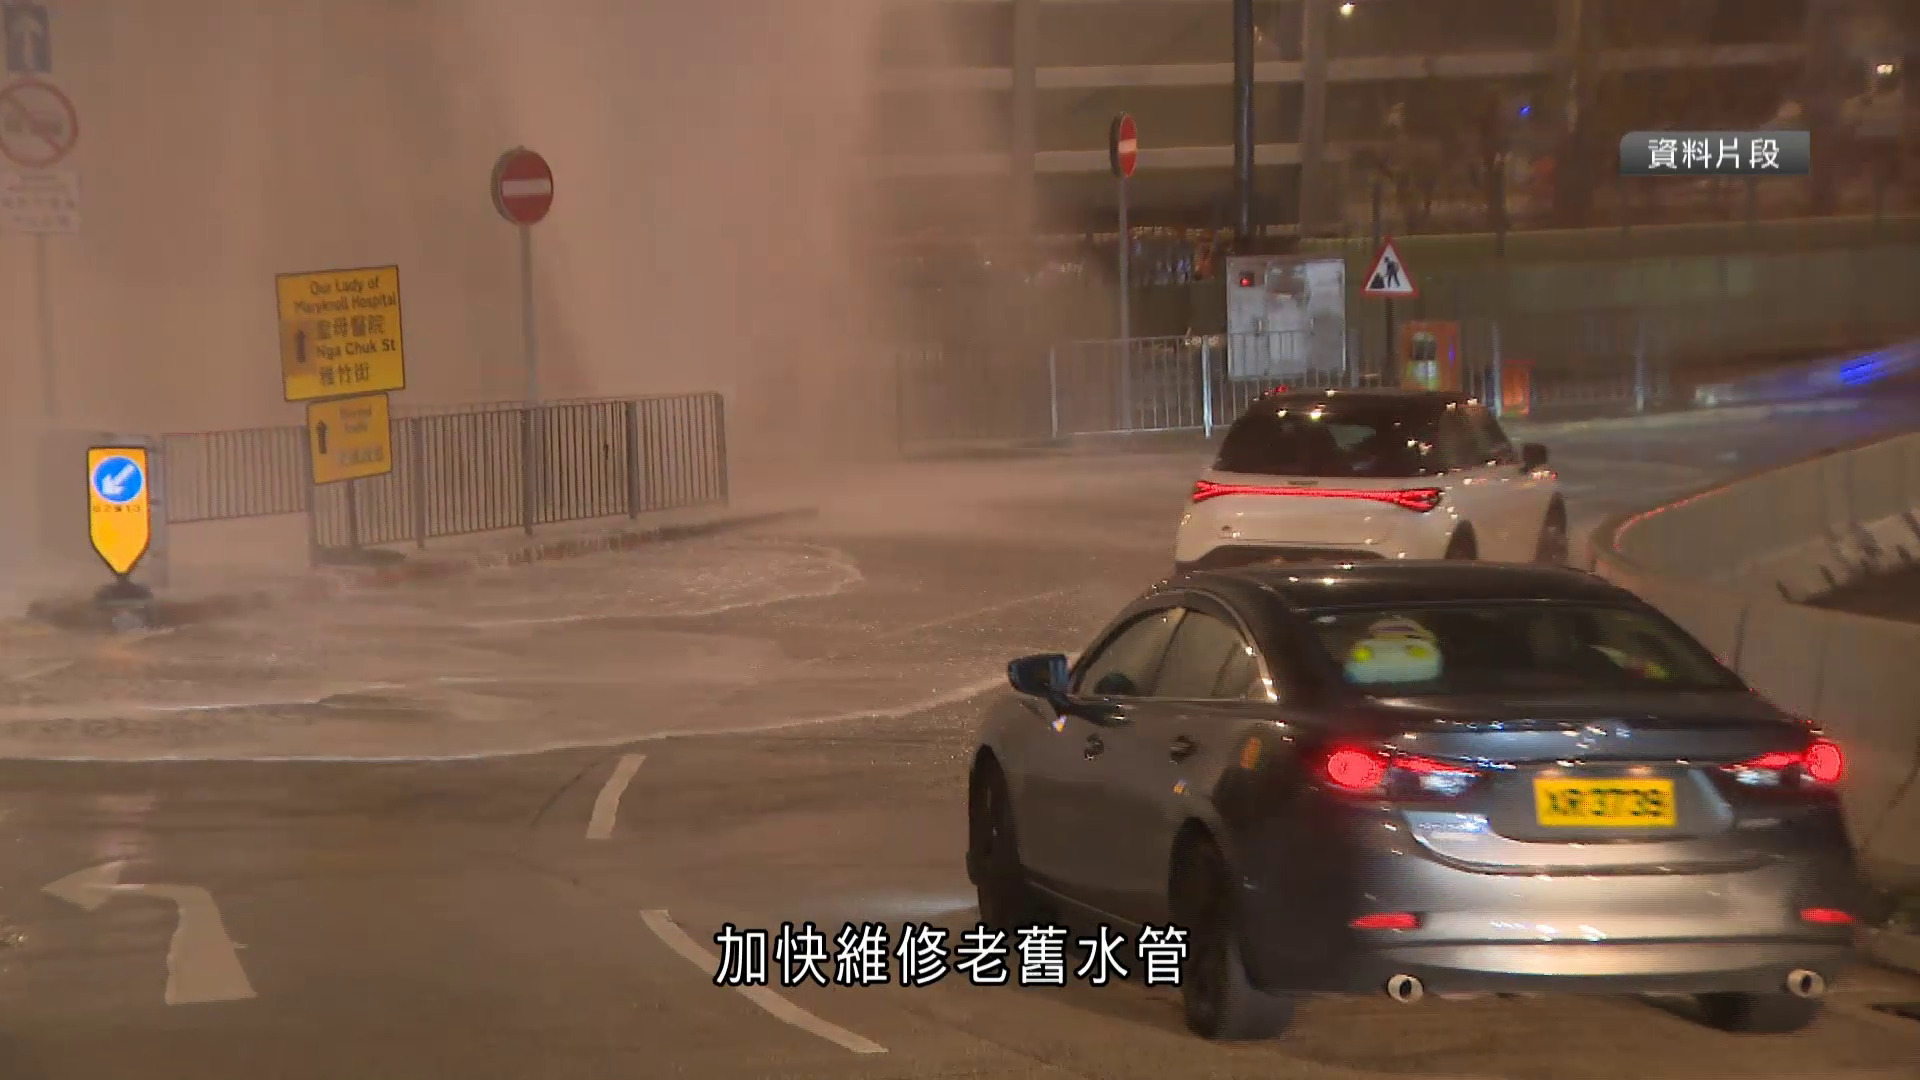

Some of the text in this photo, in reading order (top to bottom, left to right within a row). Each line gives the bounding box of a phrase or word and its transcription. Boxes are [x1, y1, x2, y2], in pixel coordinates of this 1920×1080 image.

[334, 278, 364, 293] Lady
[367, 276, 380, 289] of
[351, 291, 397, 309] Hospital
[345, 339, 377, 355] Chuk
[381, 338, 397, 352] St
